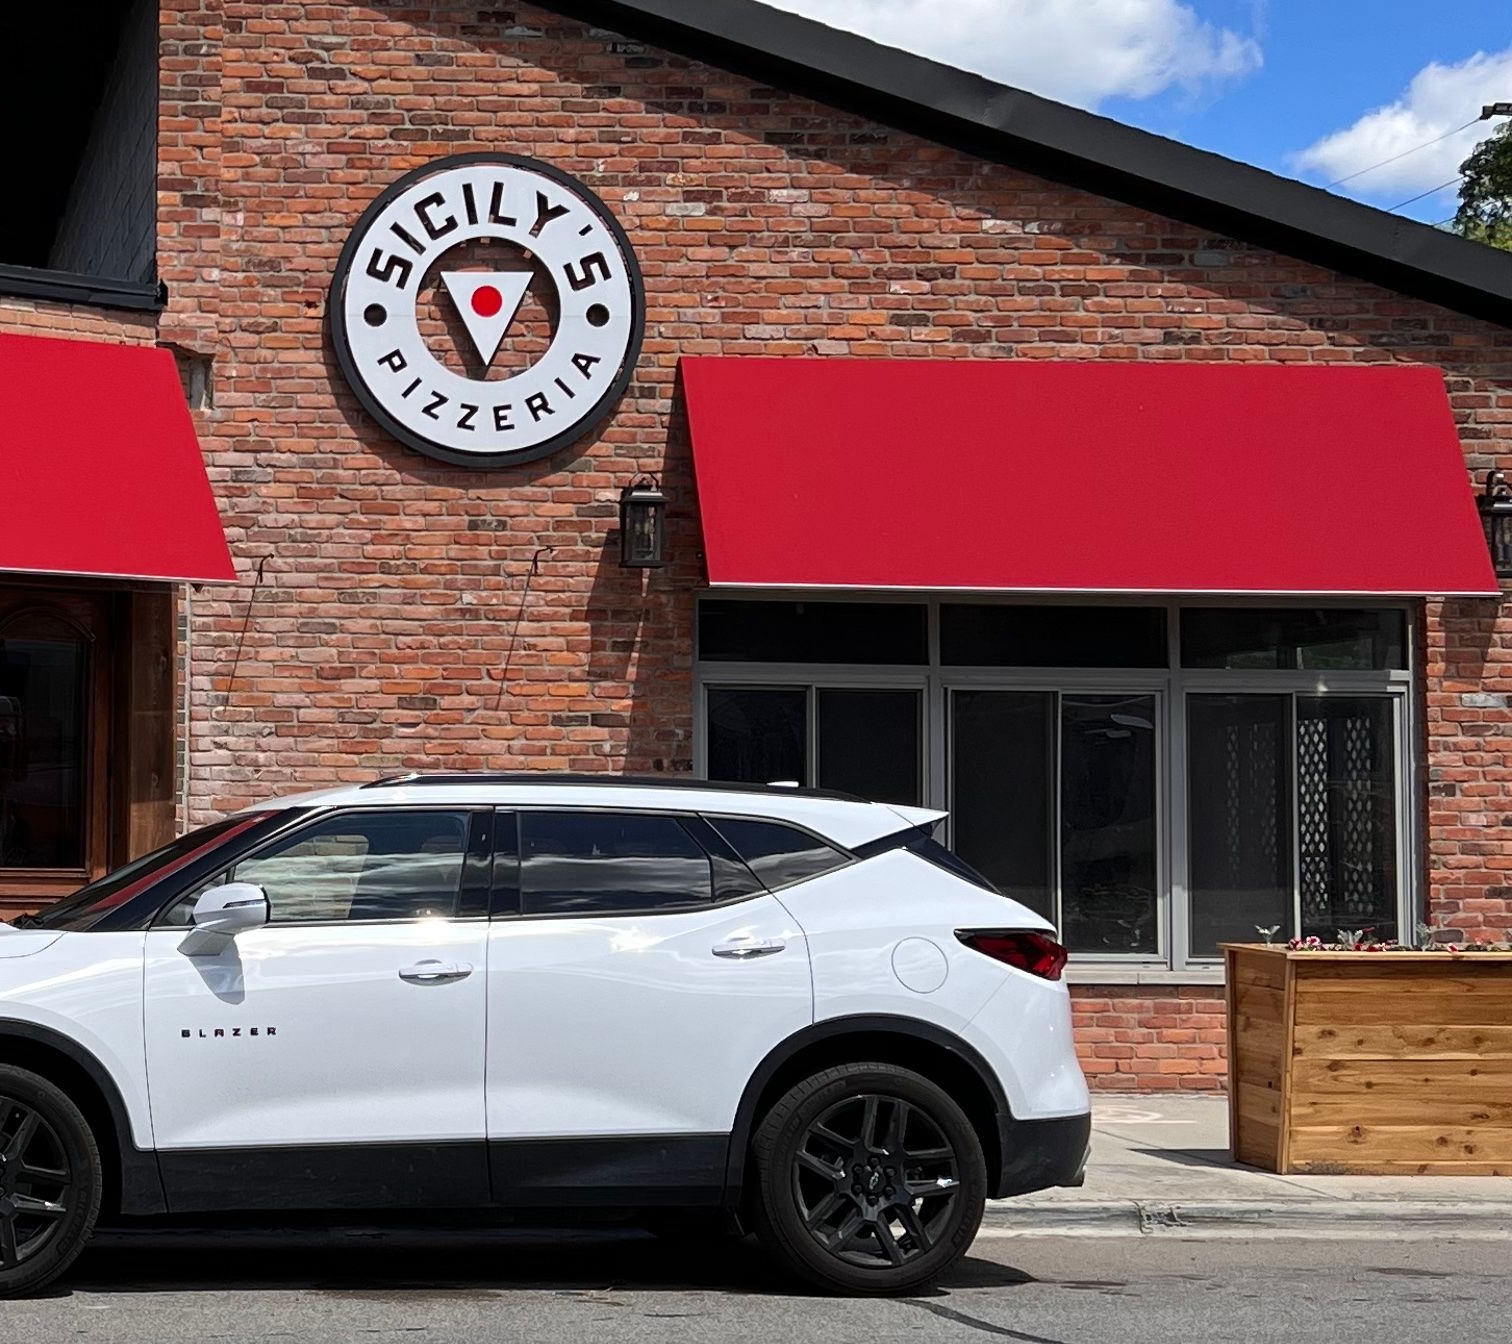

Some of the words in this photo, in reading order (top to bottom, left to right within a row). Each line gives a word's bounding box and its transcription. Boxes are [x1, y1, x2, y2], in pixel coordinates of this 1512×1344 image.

[366, 181, 612, 291] SICILY'S
[376, 347, 601, 433] PIZZERIA
[181, 1027, 277, 1038] BLAZER
